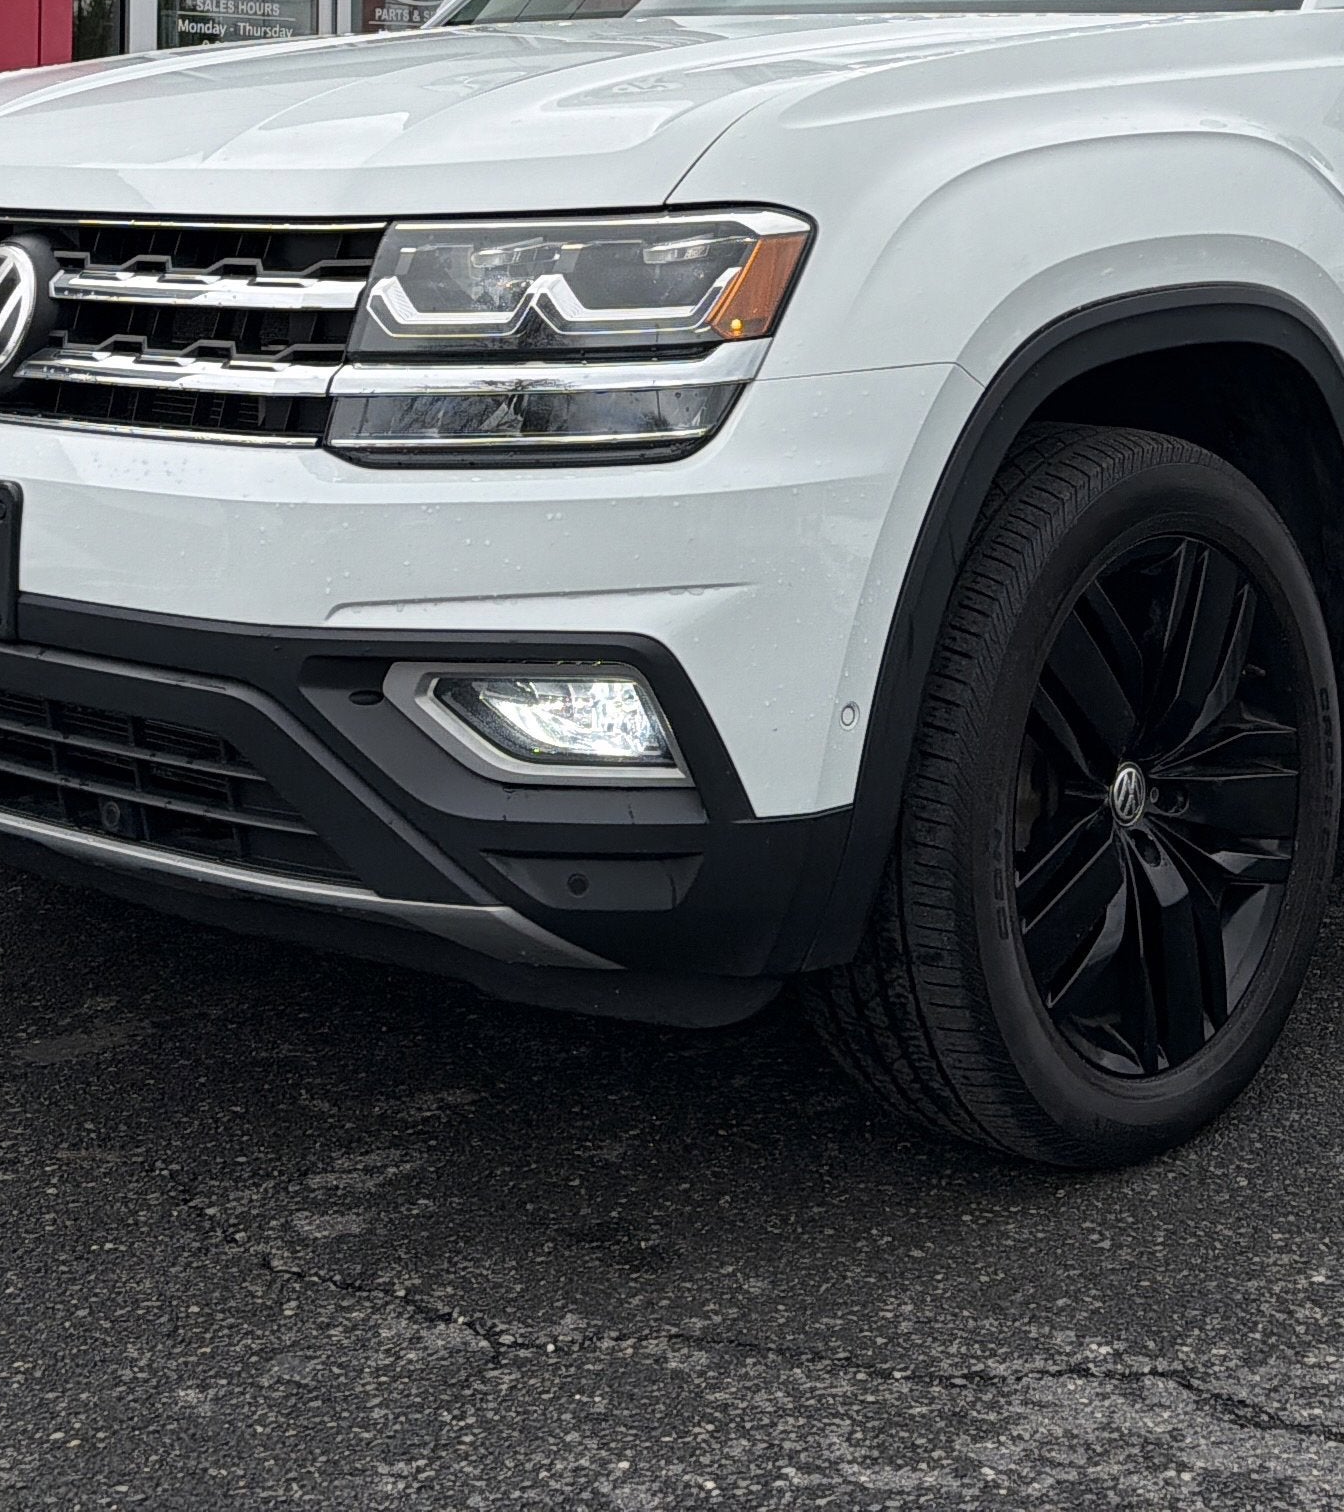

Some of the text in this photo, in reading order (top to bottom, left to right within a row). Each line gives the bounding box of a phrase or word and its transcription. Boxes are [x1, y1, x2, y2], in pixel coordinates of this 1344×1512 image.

[238, 1, 280, 16] HOURS
[375, 8, 410, 21] PARTS
[412, 10, 421, 22] &
[177, 19, 227, 37] Monday
[237, 22, 294, 38] Thursday
